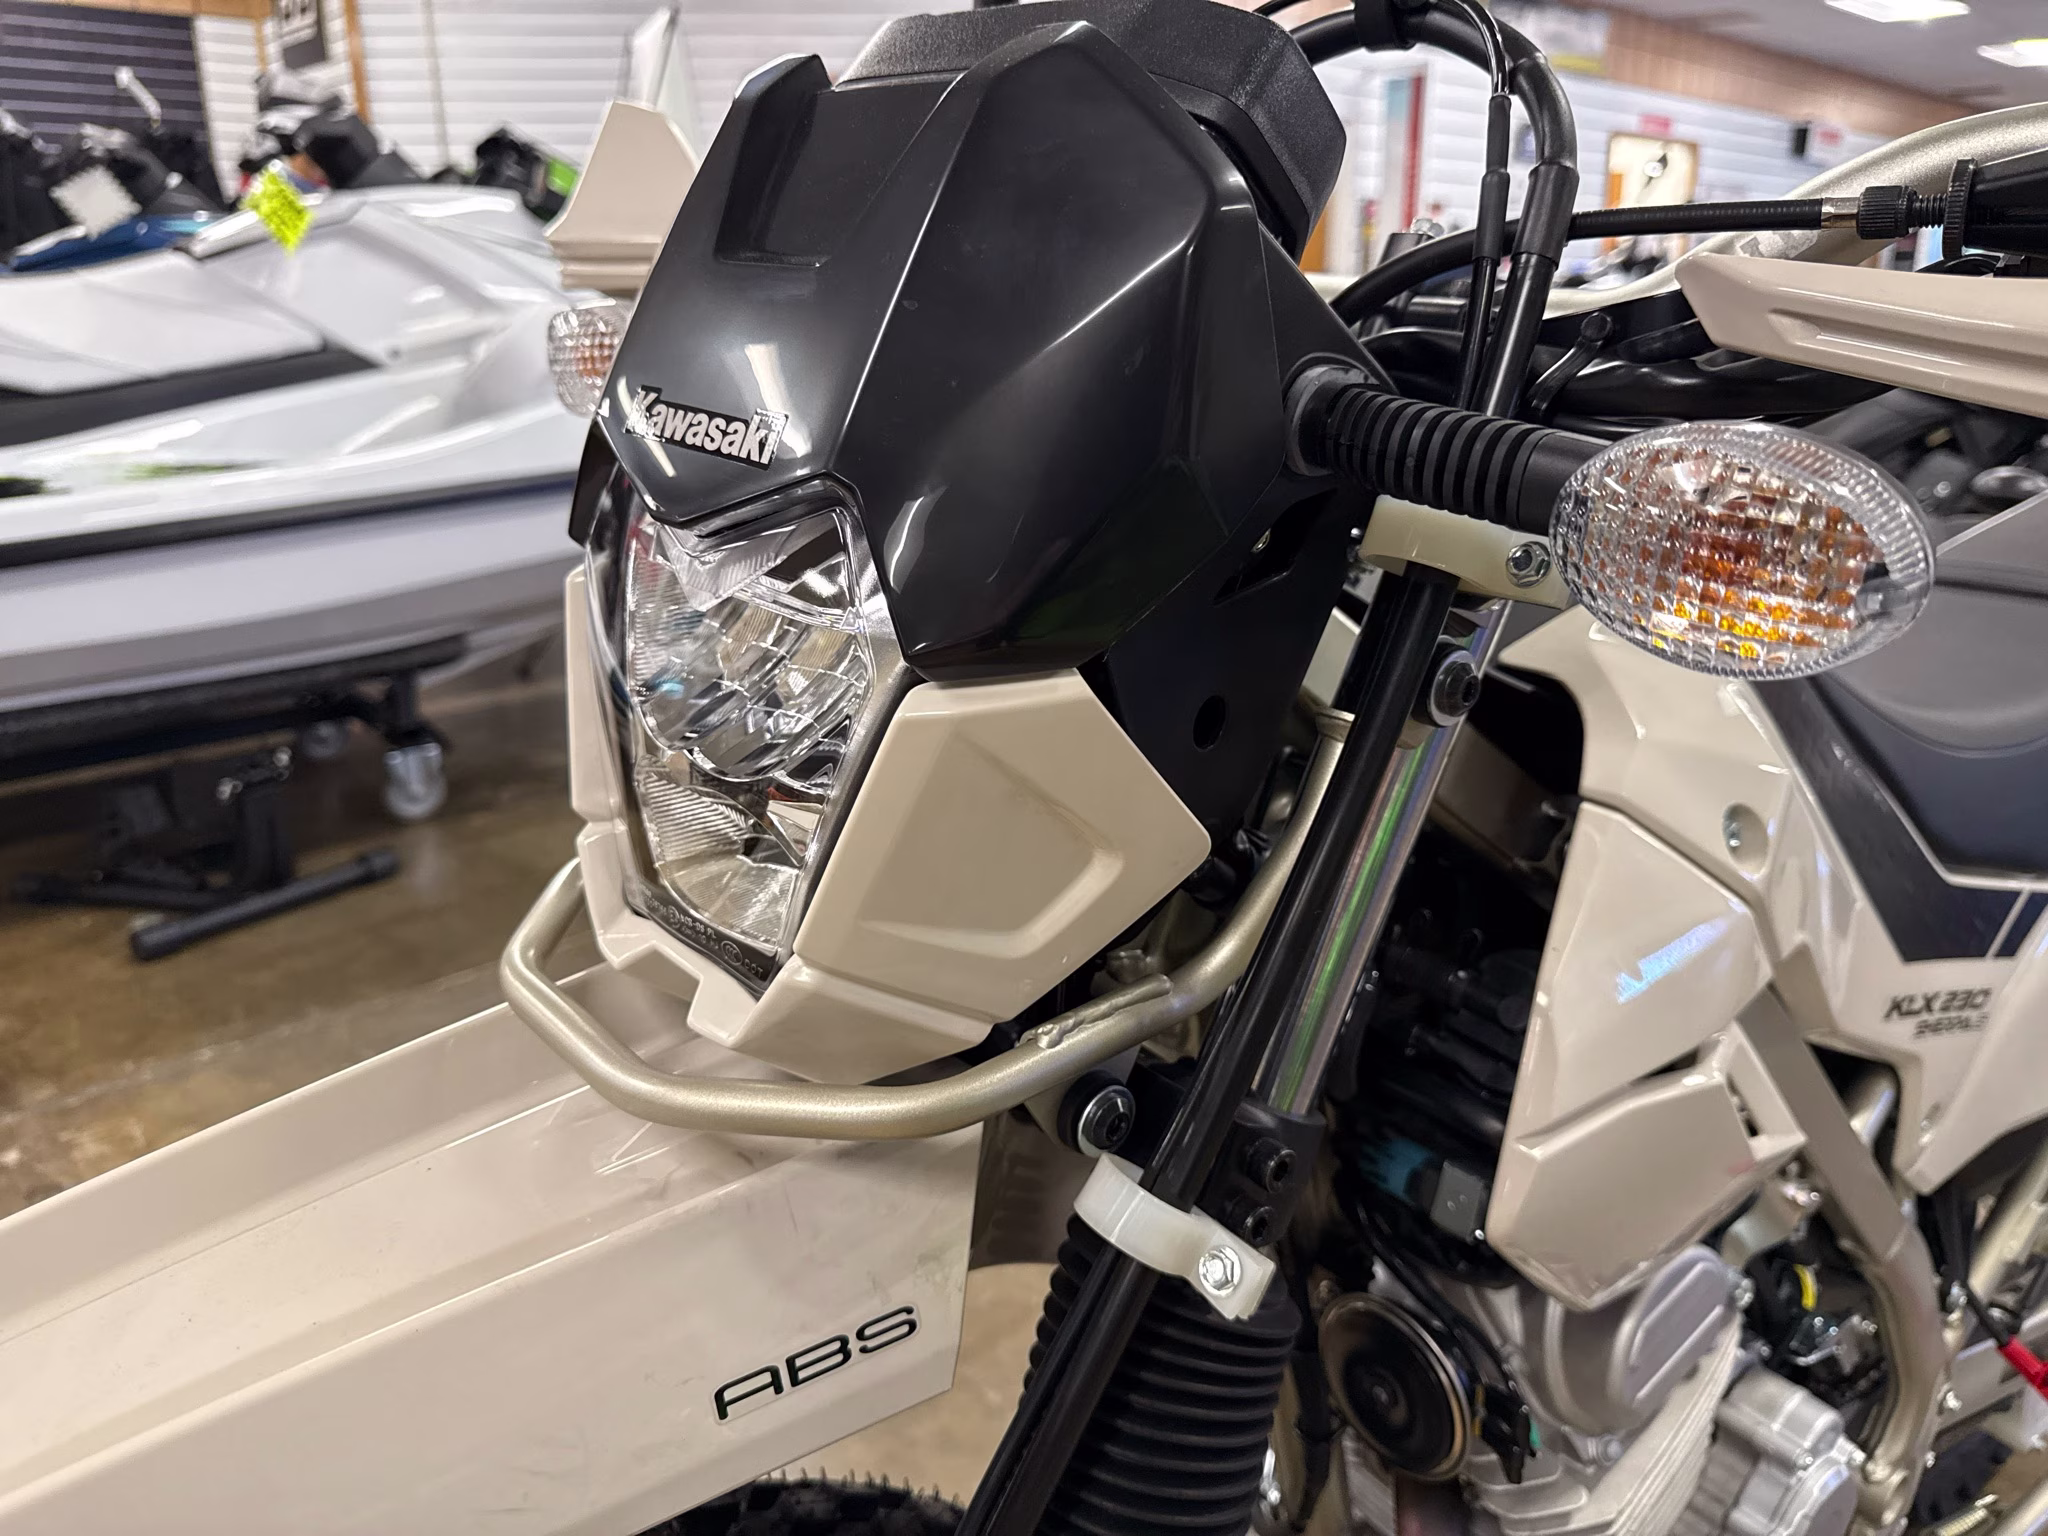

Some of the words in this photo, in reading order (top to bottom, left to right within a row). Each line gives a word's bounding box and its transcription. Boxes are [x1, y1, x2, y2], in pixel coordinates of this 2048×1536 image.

[627, 389, 782, 466] Kawasaki
[743, 957, 765, 978] DOT
[713, 1305, 918, 1421] ABS
